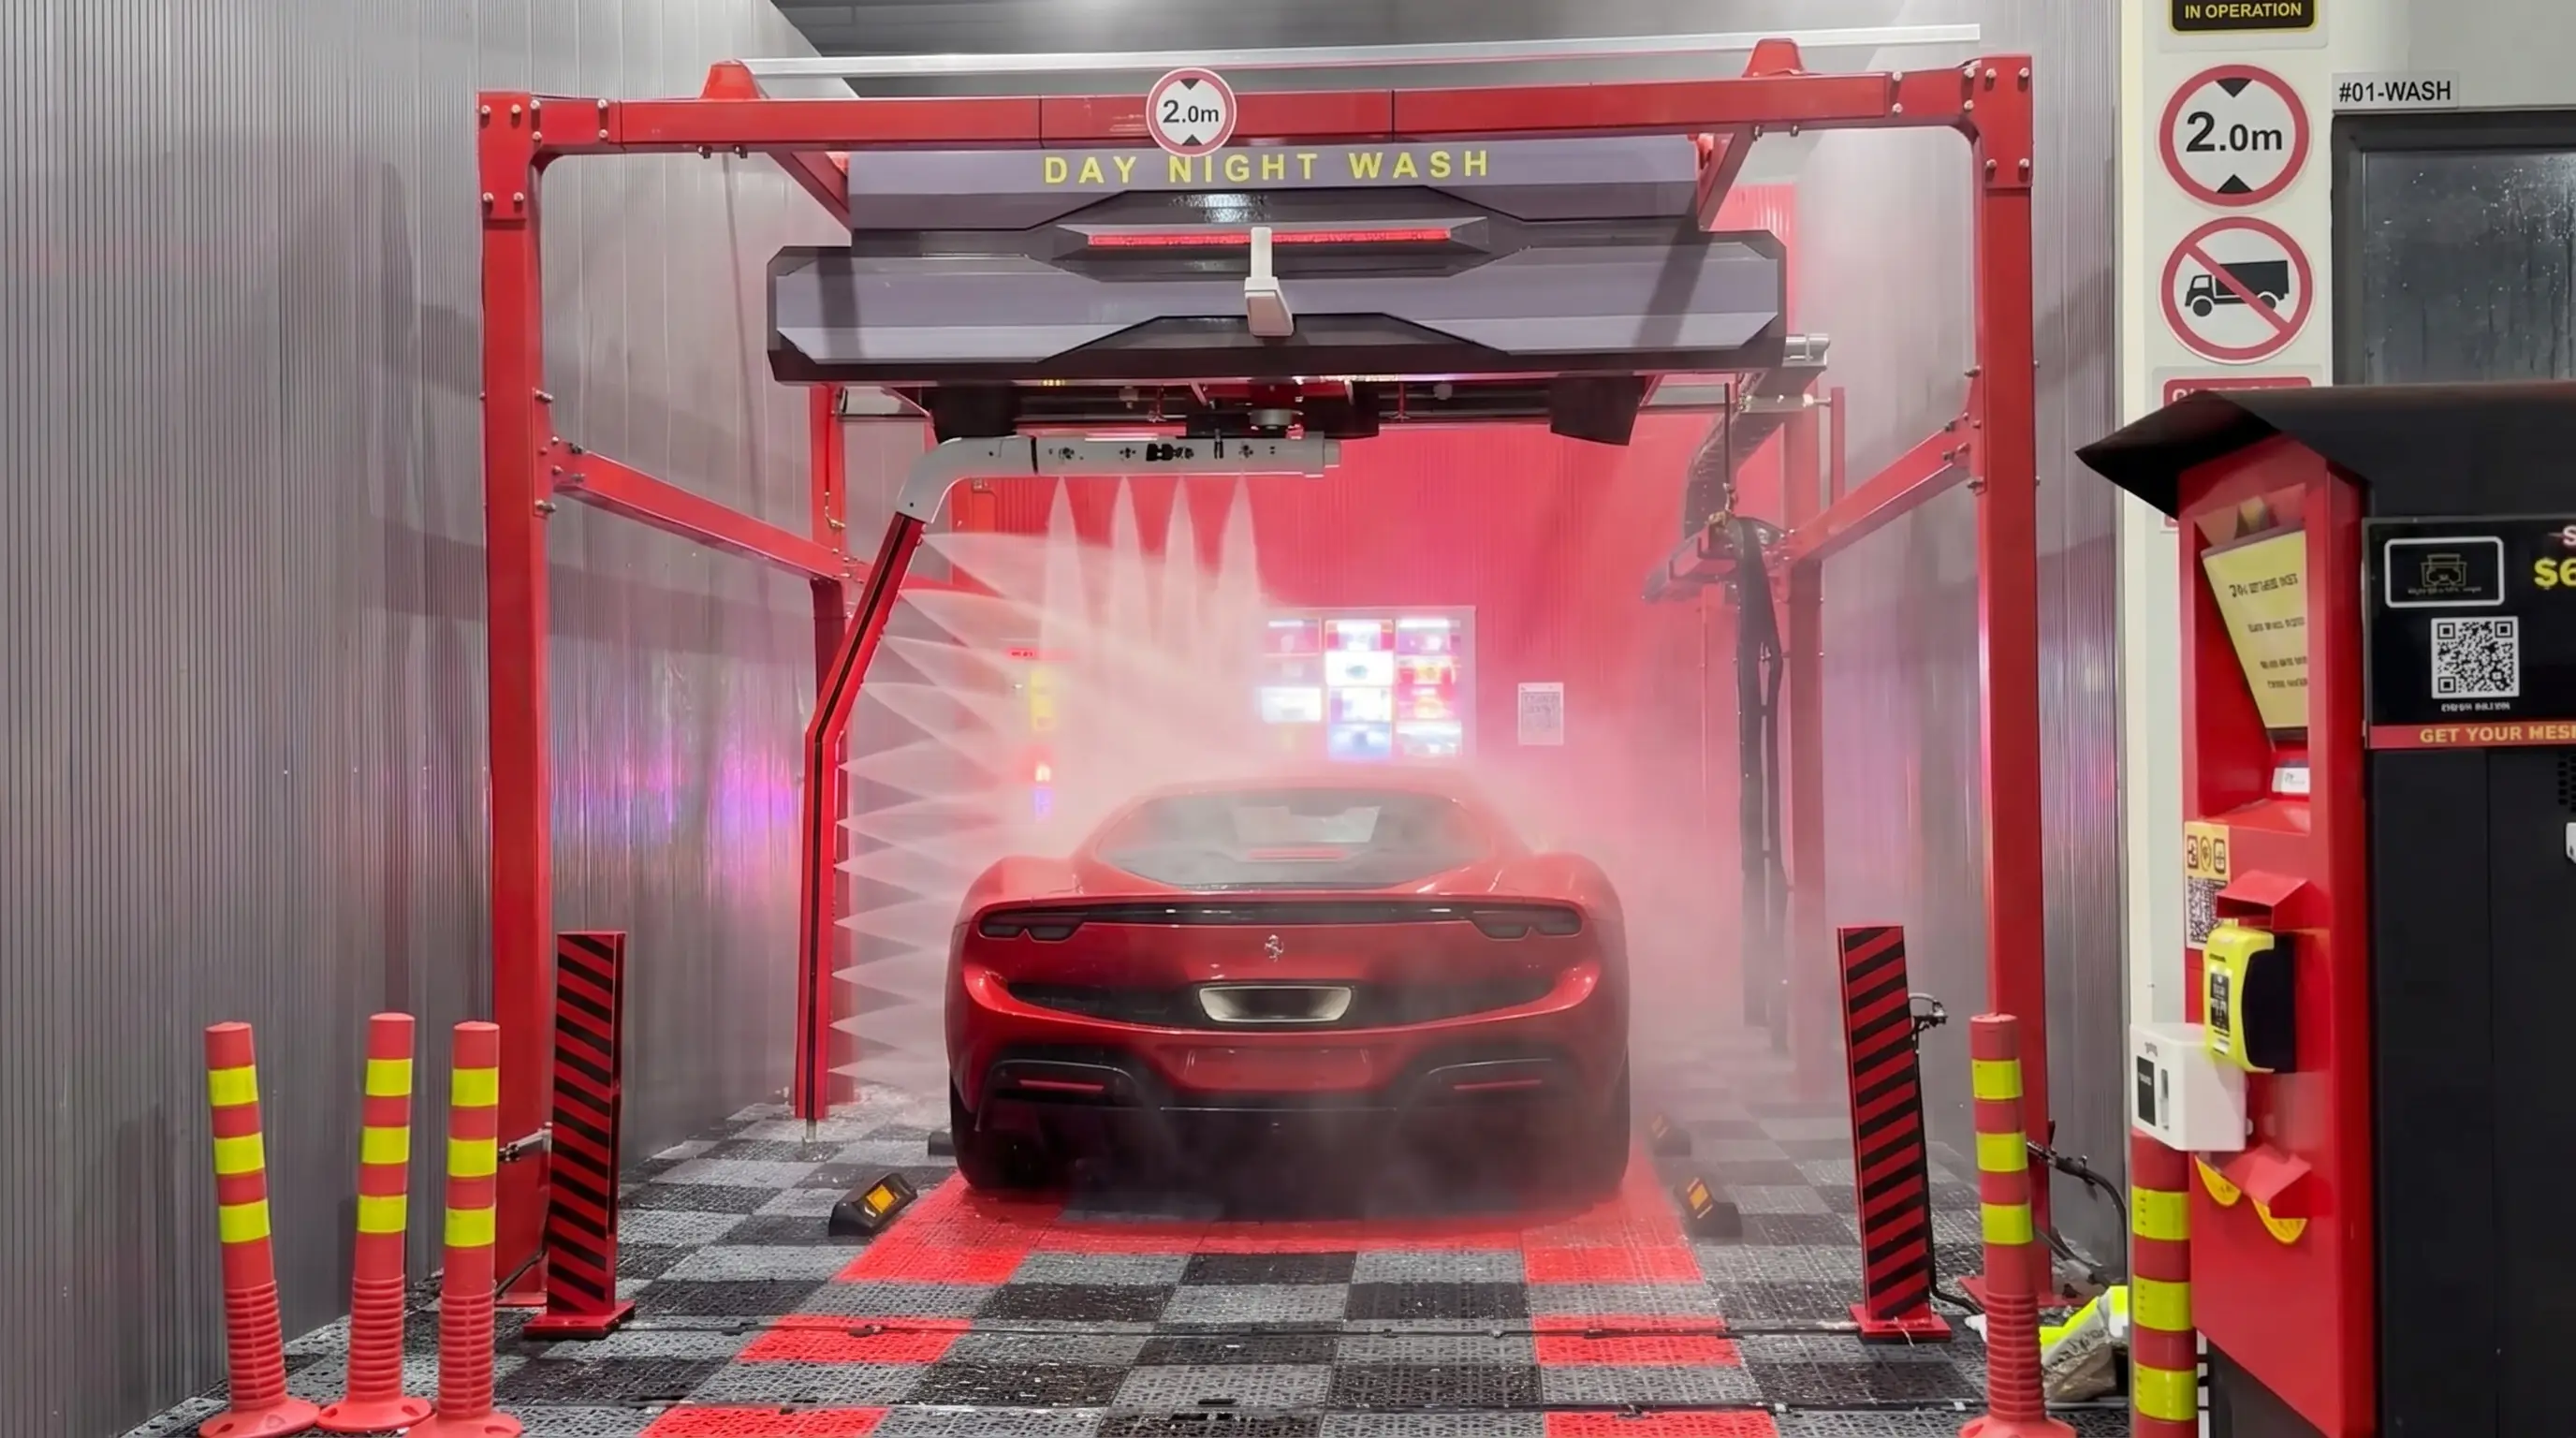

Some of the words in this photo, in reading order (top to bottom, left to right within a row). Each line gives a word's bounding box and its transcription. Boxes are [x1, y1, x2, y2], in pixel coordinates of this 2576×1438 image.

[2185, 5, 2201, 19] IN
[2205, 3, 2302, 19] OPERATION
[2338, 81, 2452, 103] #01-WASH
[1163, 99, 1220, 124] 2.0m
[2186, 111, 2283, 152] 2.0m
[1045, 155, 1136, 183] DAY
[1168, 154, 1318, 183] NIGHT
[1349, 151, 1489, 179] WASH
[2420, 727, 2460, 743] GET
[2466, 726, 2523, 741] YOUR
